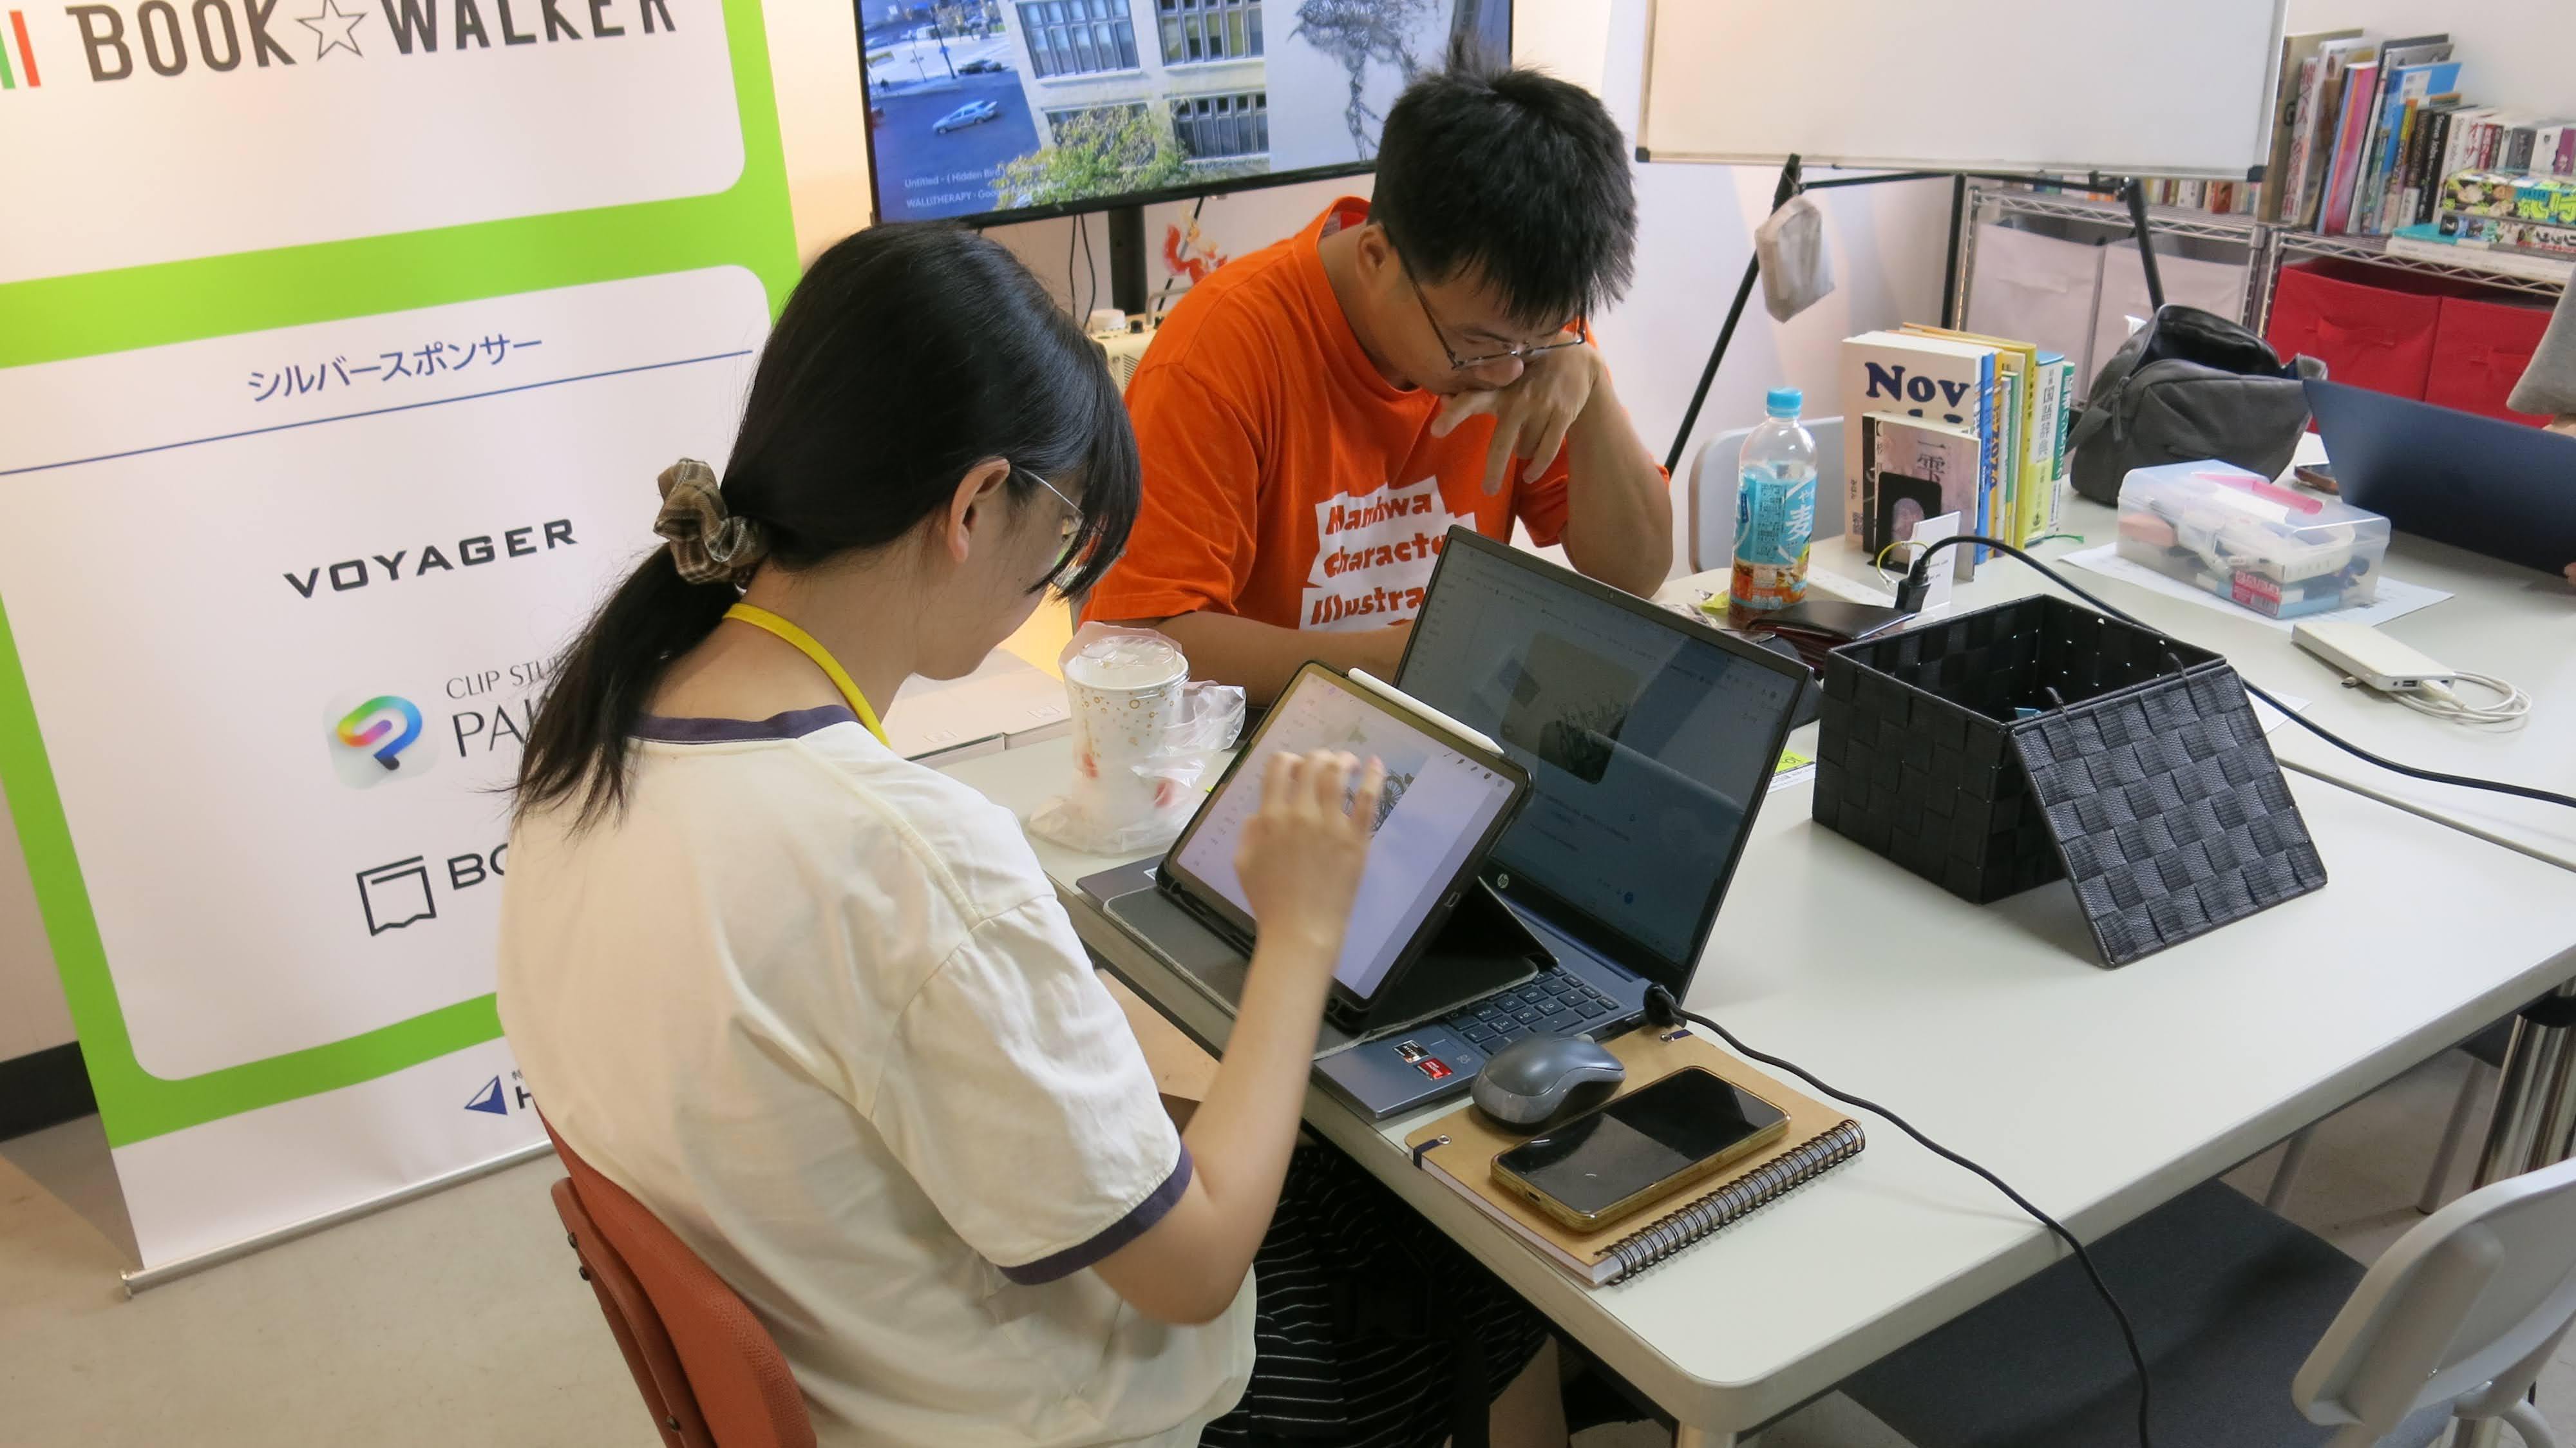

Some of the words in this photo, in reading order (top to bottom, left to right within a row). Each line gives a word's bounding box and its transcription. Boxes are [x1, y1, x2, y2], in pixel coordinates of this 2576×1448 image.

[65, 0, 298, 82] BOOK
[249, 334, 542, 402] シルバースポンサー
[1864, 361, 1971, 408] Nov
[283, 519, 578, 598] VOYAGER
[446, 670, 500, 700] CLIP
